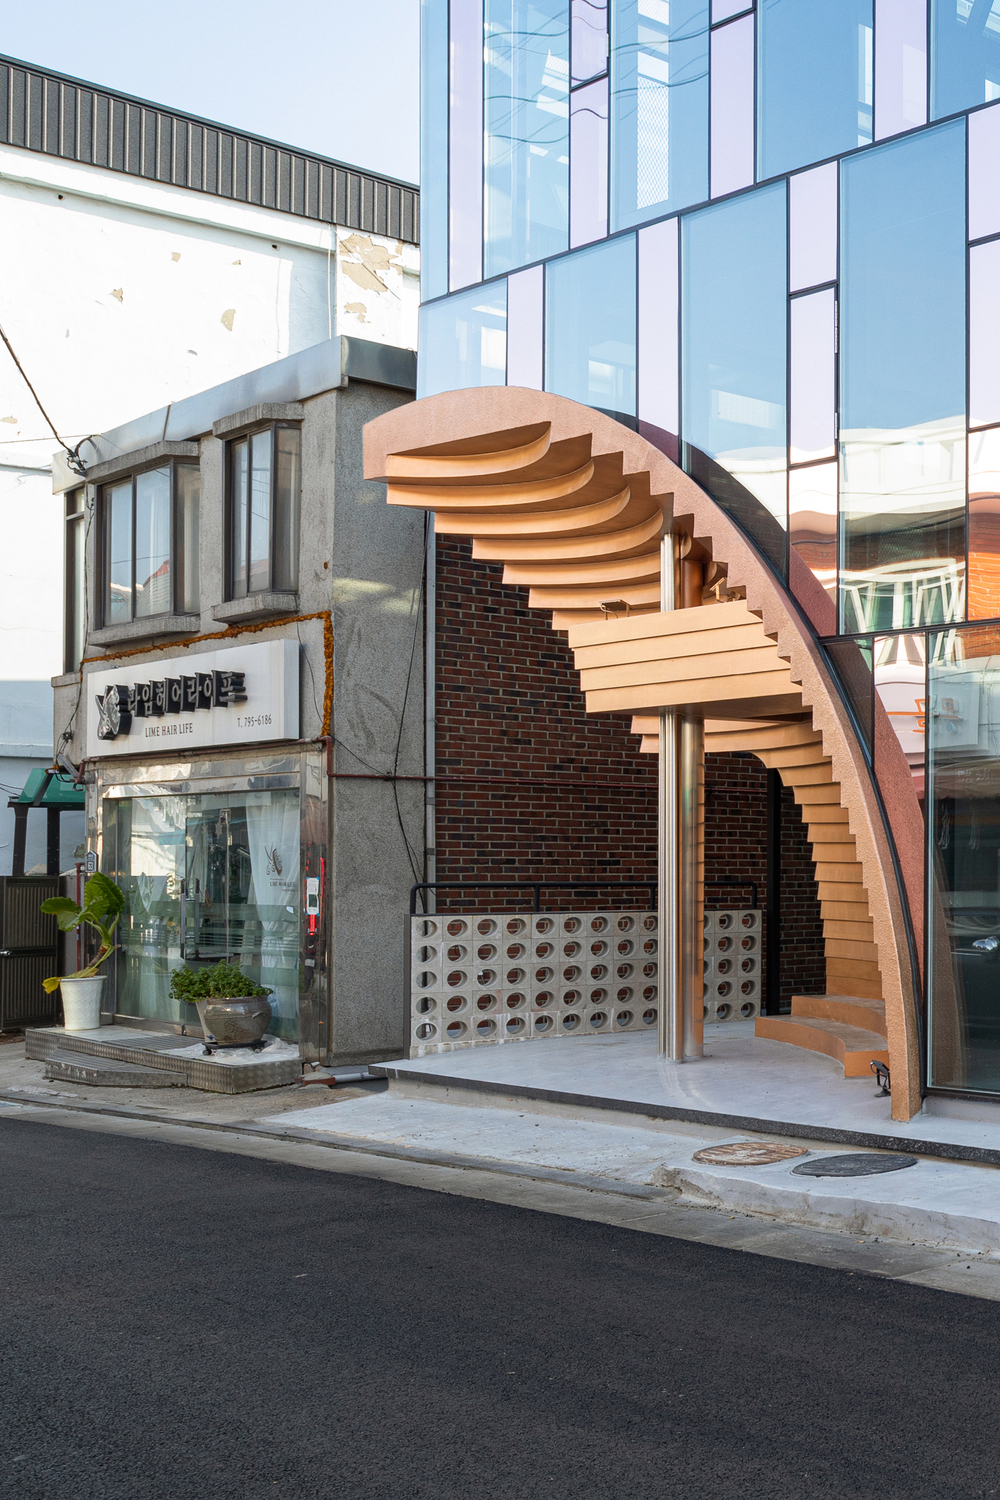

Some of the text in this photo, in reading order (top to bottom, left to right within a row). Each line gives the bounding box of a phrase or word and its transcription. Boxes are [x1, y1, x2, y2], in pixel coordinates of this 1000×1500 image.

[128, 670, 247, 717] 라임헤어라이프
[237, 713, 272, 728] T. 795-6186
[145, 722, 194, 737] LIME HAIR LIFE
